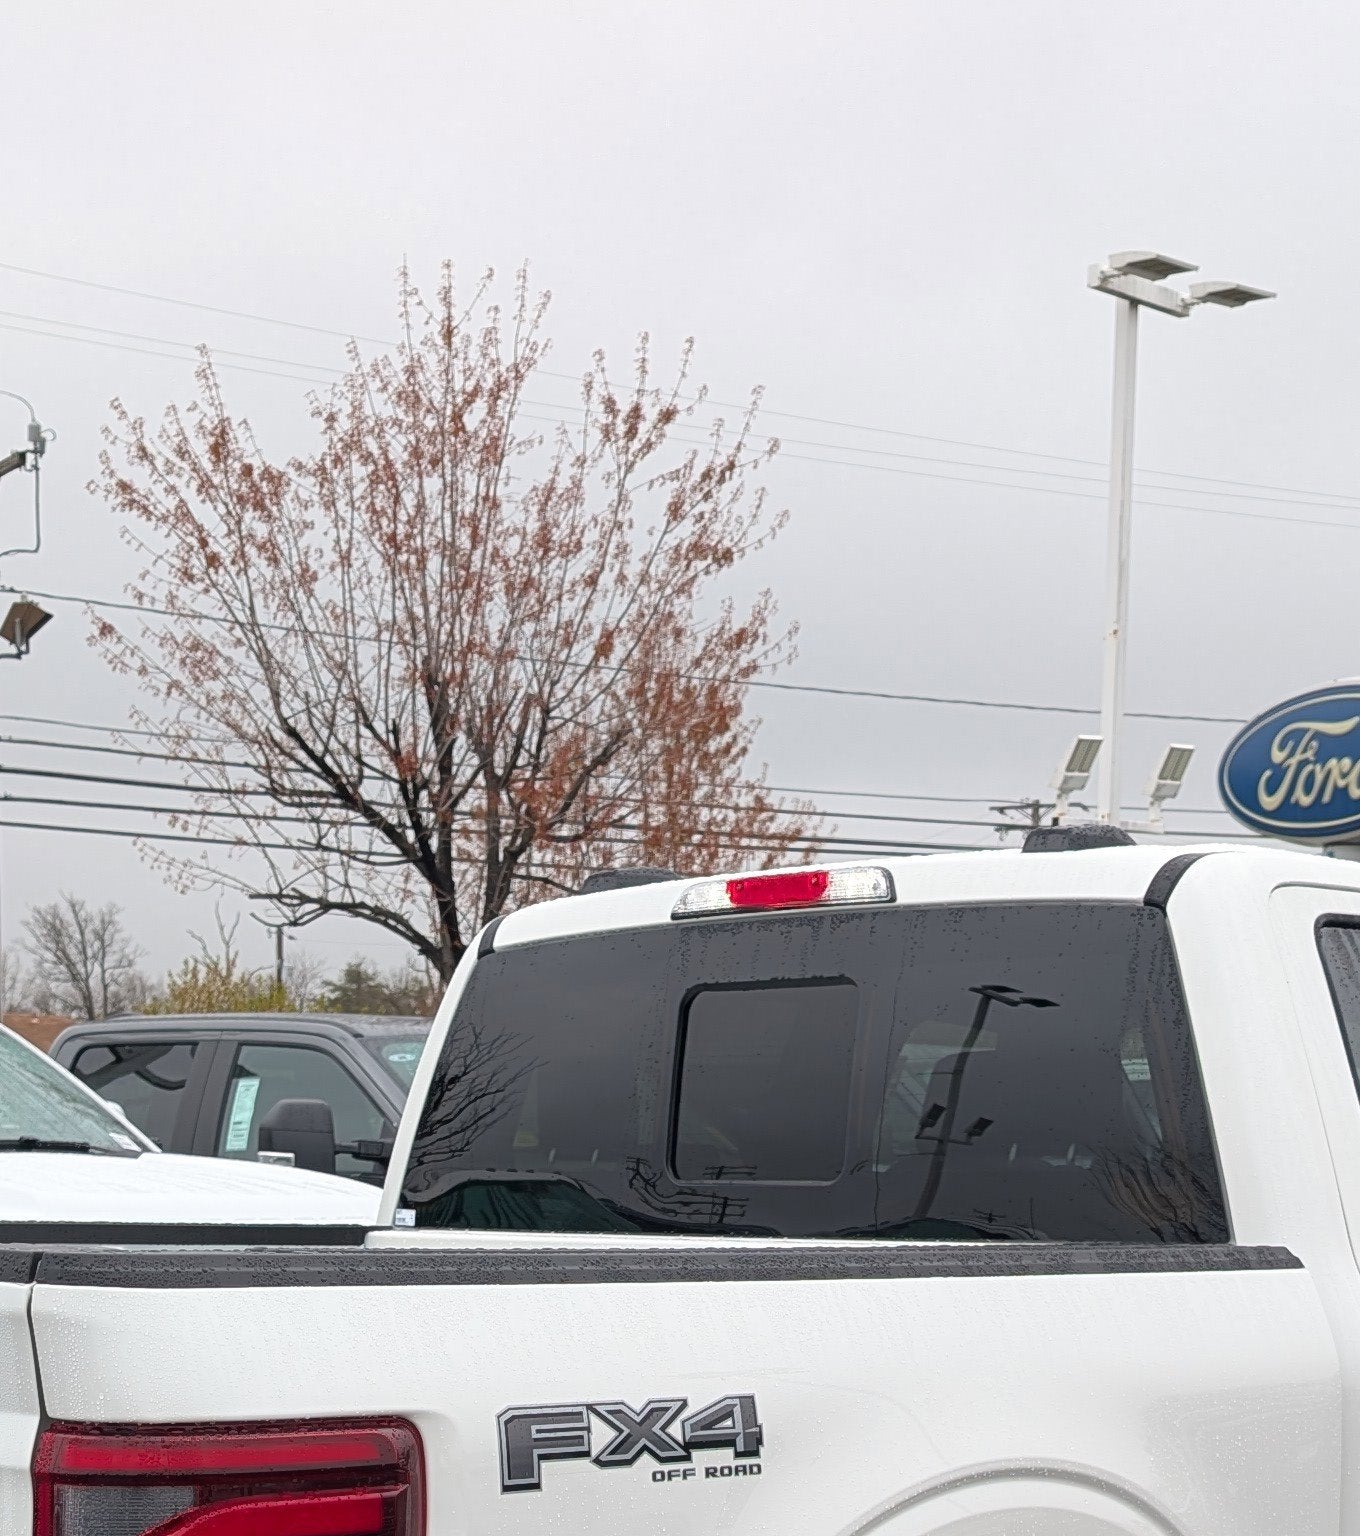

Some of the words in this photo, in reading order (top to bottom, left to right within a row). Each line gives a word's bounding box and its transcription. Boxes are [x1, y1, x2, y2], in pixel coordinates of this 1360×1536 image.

[495, 1393, 765, 1495] FX4
[651, 1467, 697, 1483] OFF
[703, 1462, 763, 1479] ROAD
